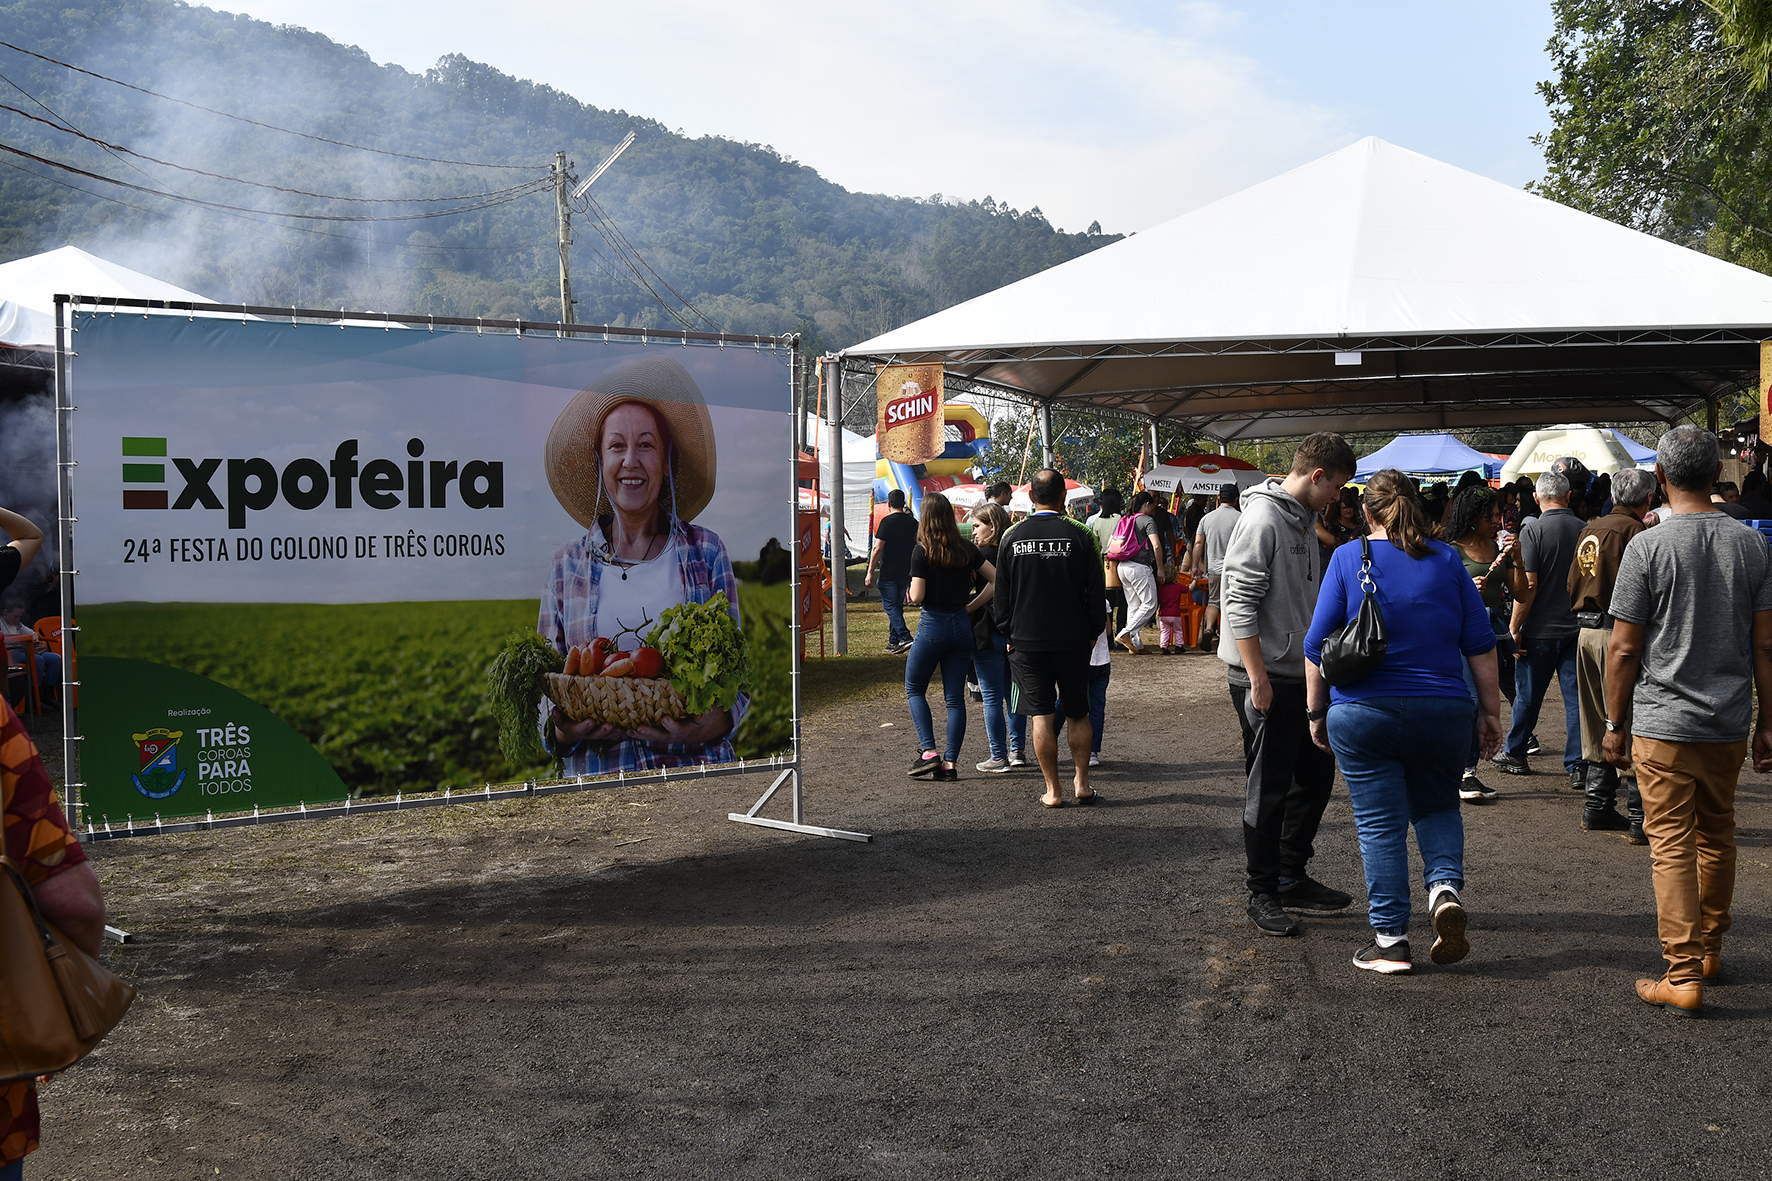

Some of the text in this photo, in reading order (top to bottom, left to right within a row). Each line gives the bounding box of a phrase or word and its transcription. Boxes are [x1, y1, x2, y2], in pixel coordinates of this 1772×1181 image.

[888, 395, 932, 423] SCHIN
[122, 437, 504, 529] Expofeira
[1150, 479, 1172, 489] AMSTEL
[123, 530, 505, 563] 24ª FESTA DO COLONO DE TRÊS COROAS
[1012, 541, 1035, 554] Tchê!
[167, 707, 212, 717] Realização
[196, 722, 251, 748] TRÊS
[197, 747, 251, 762] COROAS
[198, 759, 252, 780] PARA
[198, 778, 252, 796] TODOS
